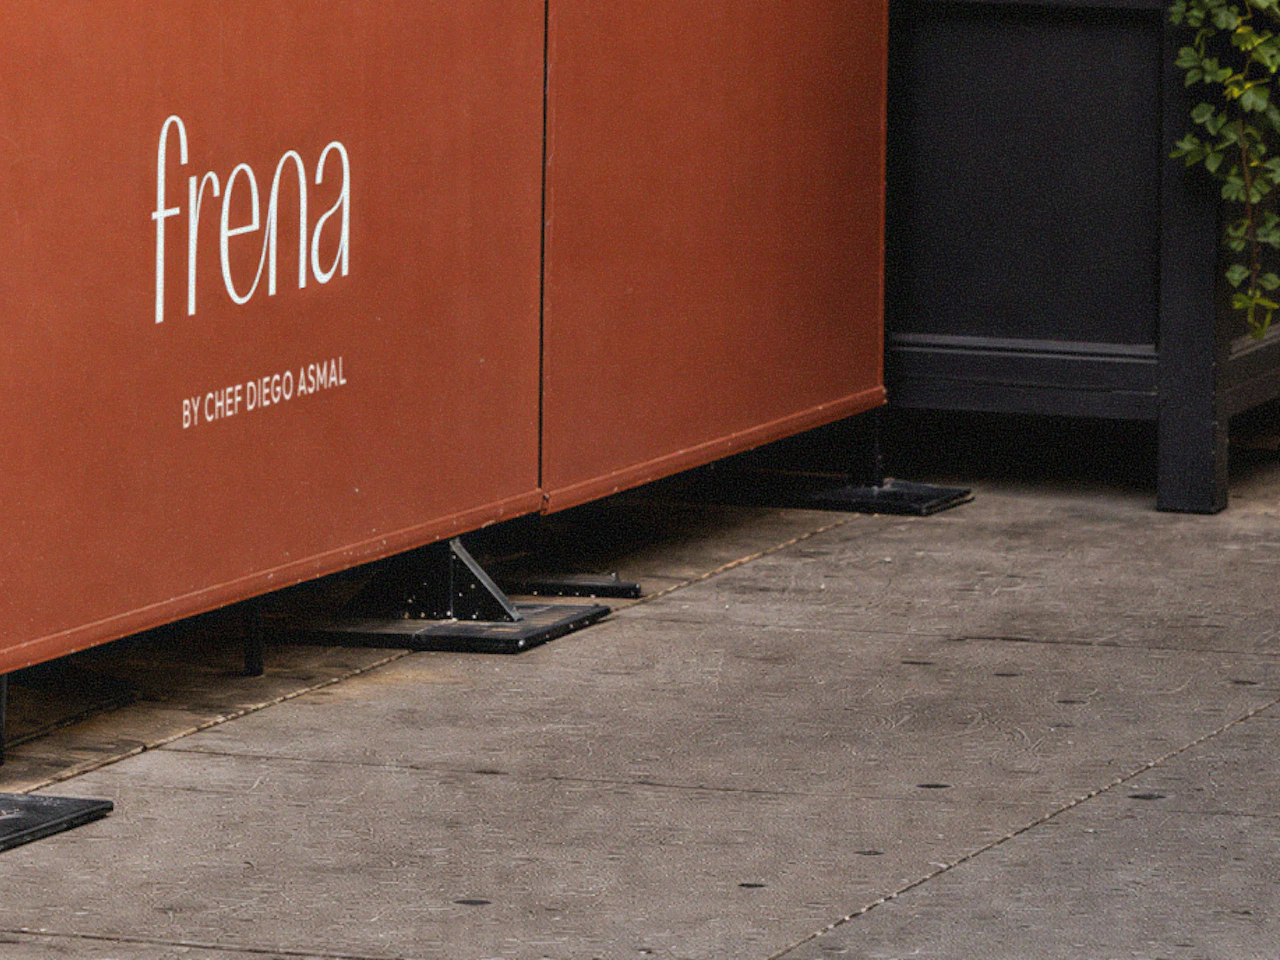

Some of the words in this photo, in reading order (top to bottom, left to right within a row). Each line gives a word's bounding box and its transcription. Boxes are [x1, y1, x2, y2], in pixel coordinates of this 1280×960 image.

[151, 115, 351, 324] frena
[182, 397, 201, 429] BY
[204, 384, 243, 422] CHEF
[246, 370, 293, 411] DIEGO
[297, 356, 347, 396] ASMAL
